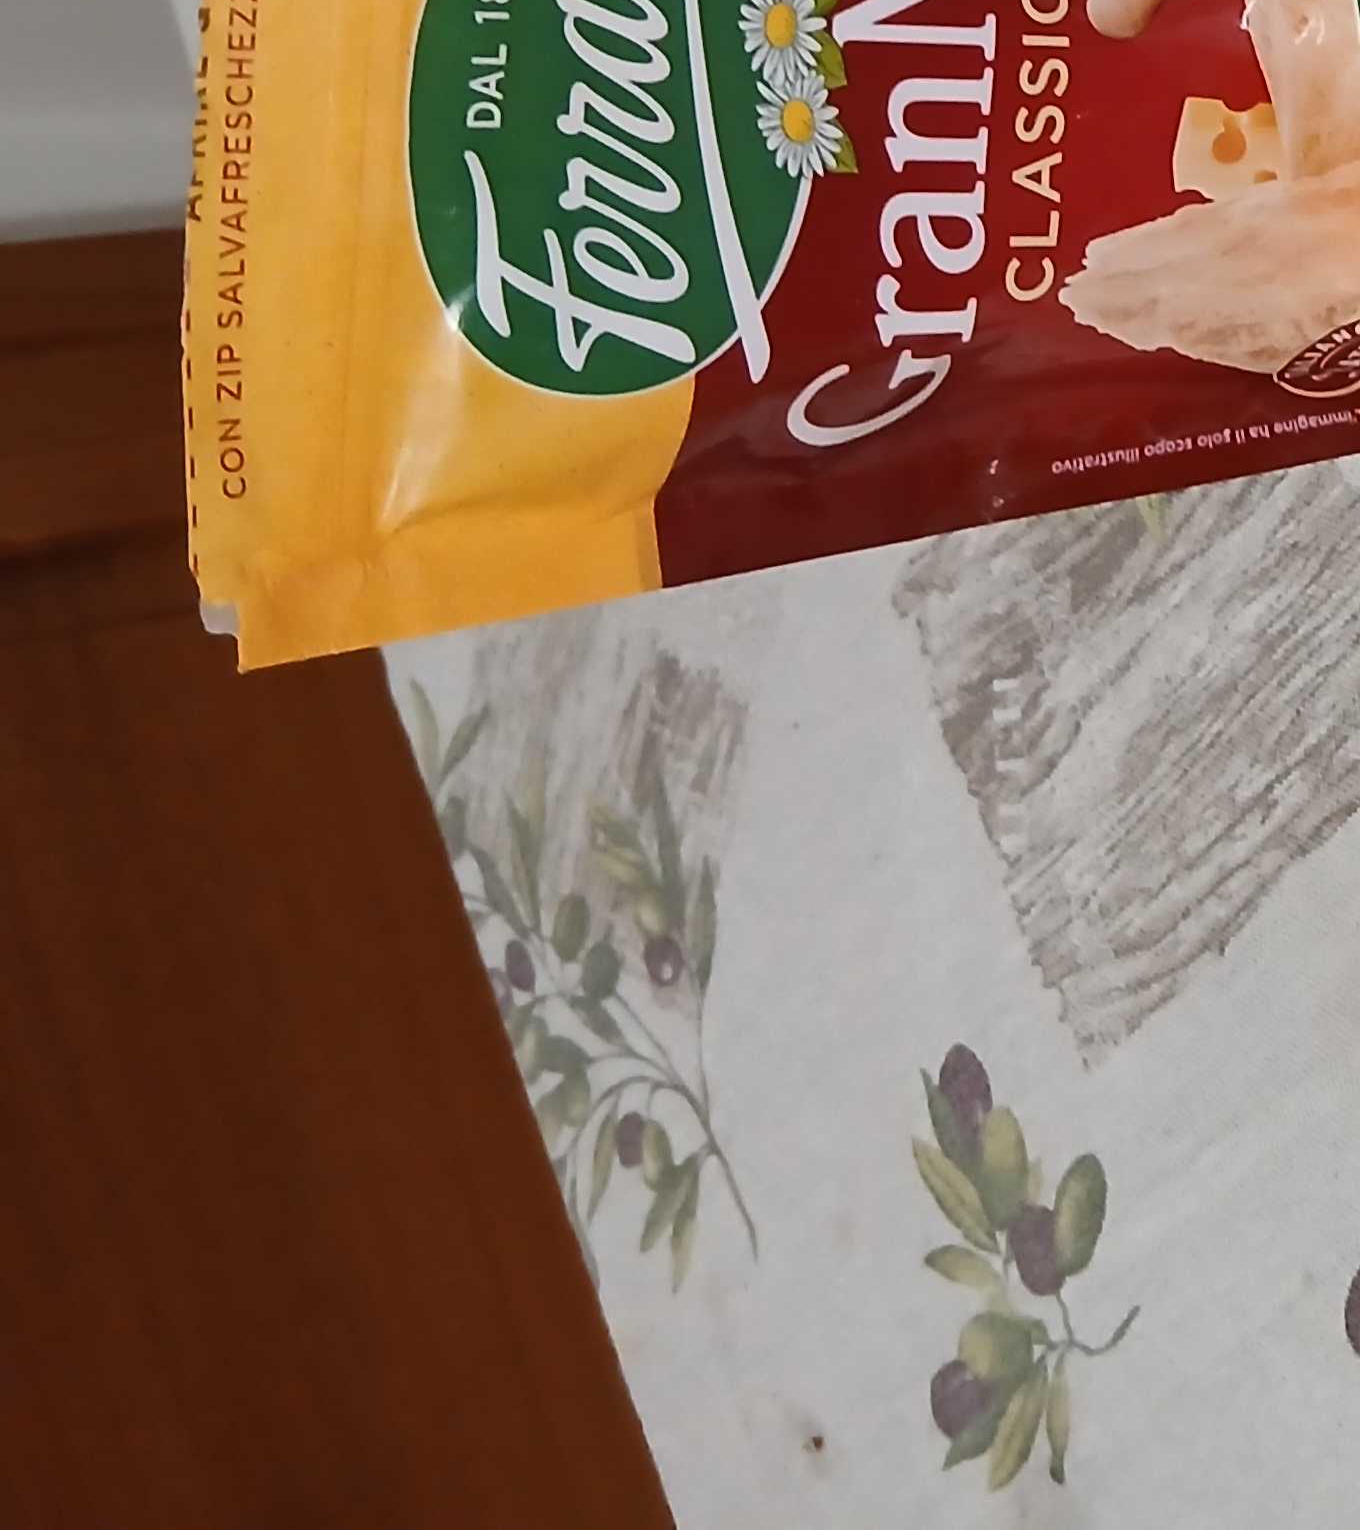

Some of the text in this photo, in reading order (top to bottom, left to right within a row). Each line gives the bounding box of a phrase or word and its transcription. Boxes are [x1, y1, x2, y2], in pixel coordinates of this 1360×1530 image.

[466, 43, 508, 129] DAL
[216, 343, 243, 402] ZIP
[1197, 427, 1234, 449] solo
[1235, 428, 1247, 444] il
[1250, 423, 1272, 438] ha
[1143, 436, 1193, 457] scopo
[216, 419, 246, 500] CON
[1051, 446, 1140, 474] illustrativo
